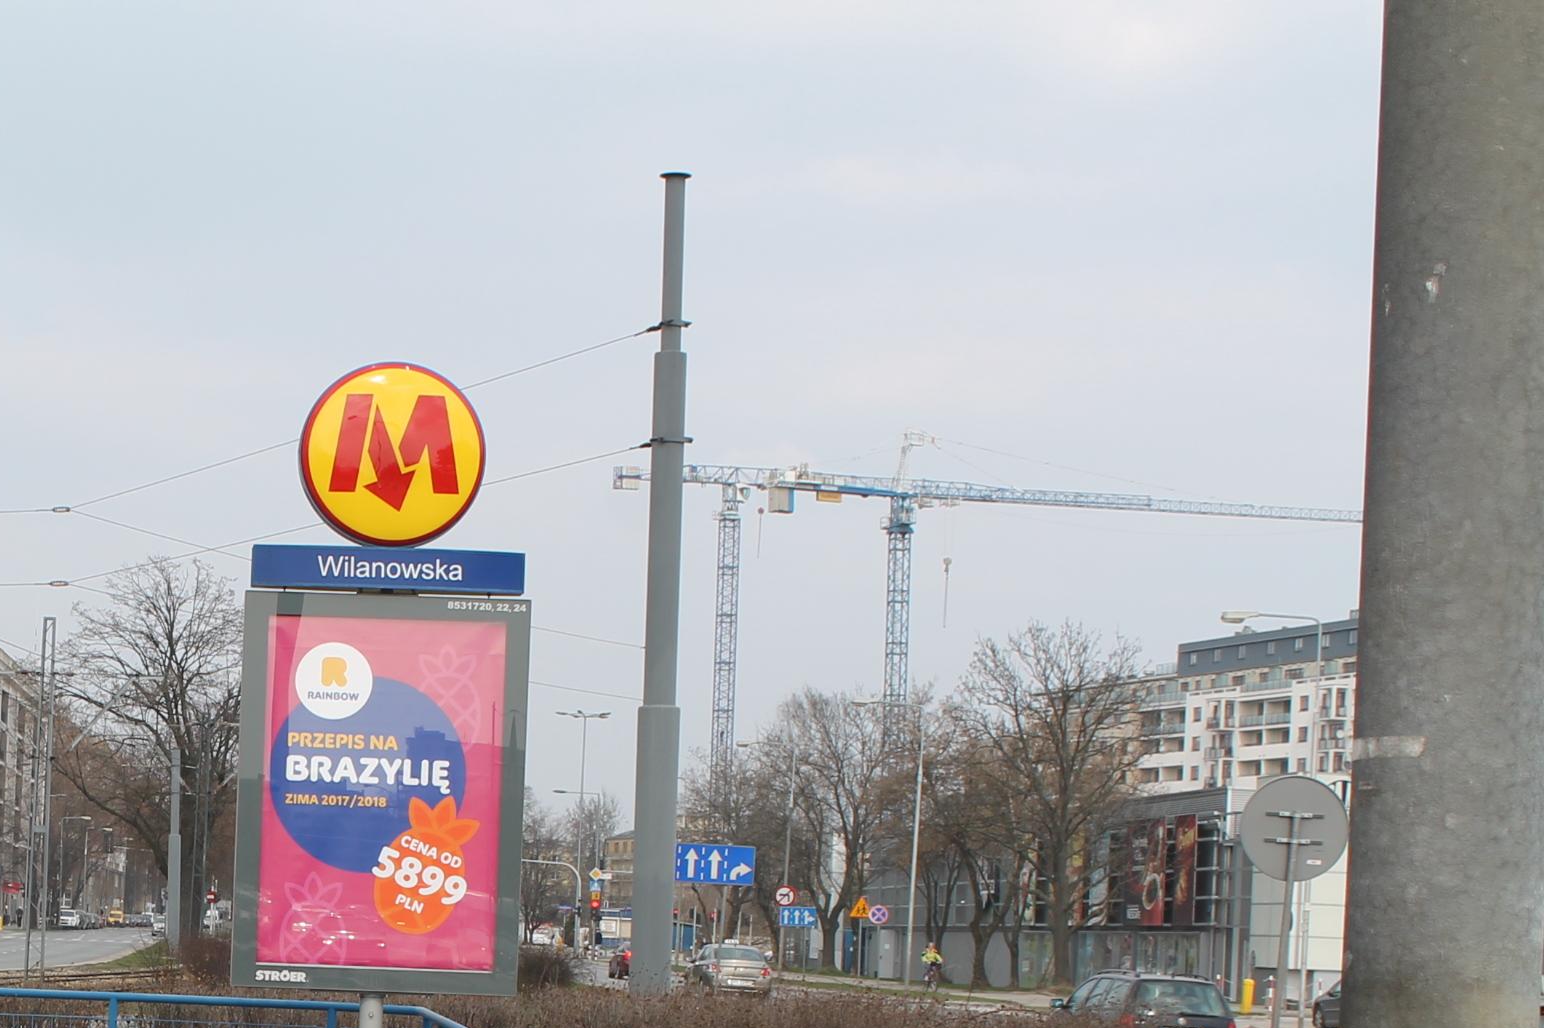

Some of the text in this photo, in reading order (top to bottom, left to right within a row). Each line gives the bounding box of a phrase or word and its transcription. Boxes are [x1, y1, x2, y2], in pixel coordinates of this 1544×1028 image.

[328, 393, 460, 512] M
[317, 555, 463, 582] Wilanowska
[513, 603, 527, 613] 24
[321, 656, 348, 687] R
[307, 690, 360, 701] RAINBOW
[287, 732, 399, 750] PRZEPIS NA
[285, 754, 451, 795] BRAZYLIĘ
[285, 793, 387, 808] ZIMA 2017/2018
[400, 835, 462, 868] CENA OD
[371, 846, 467, 905] 5899
[395, 894, 424, 914] PLN
